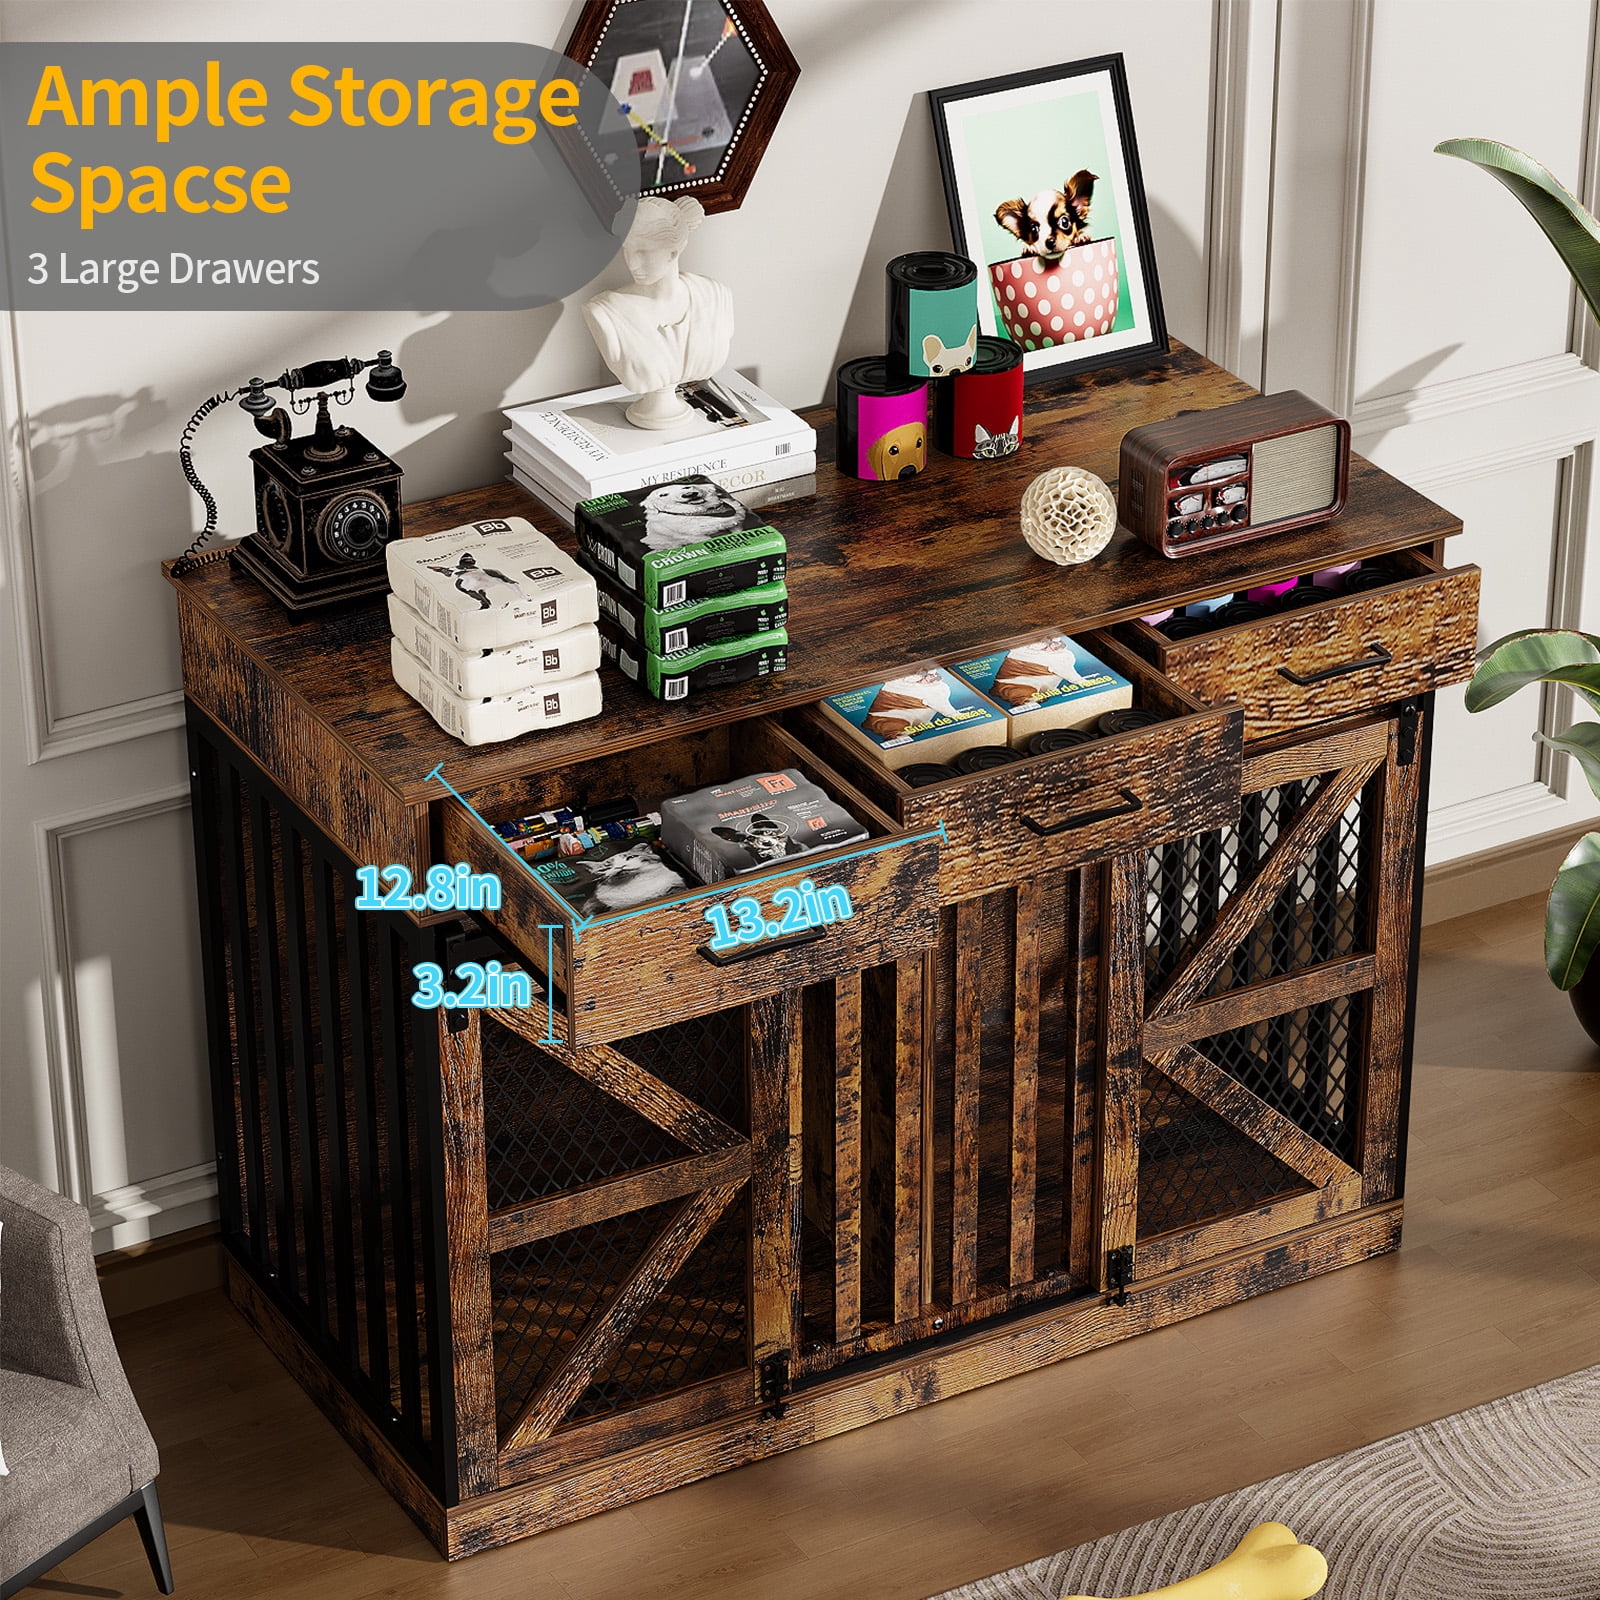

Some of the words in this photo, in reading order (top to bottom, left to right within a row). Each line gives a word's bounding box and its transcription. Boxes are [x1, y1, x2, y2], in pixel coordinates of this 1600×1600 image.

[640, 473, 660, 488] MY
[661, 458, 728, 483] RESIDENCE
[718, 468, 766, 490] ECOR
[480, 520, 507, 533] Bb
[703, 527, 775, 551] ORIGINAL
[650, 547, 710, 570] CROWN
[530, 567, 556, 578] Bb
[542, 606, 556, 620] Bb
[544, 653, 559, 667] Bb
[545, 699, 560, 712] Bb
[934, 716, 953, 727] de
